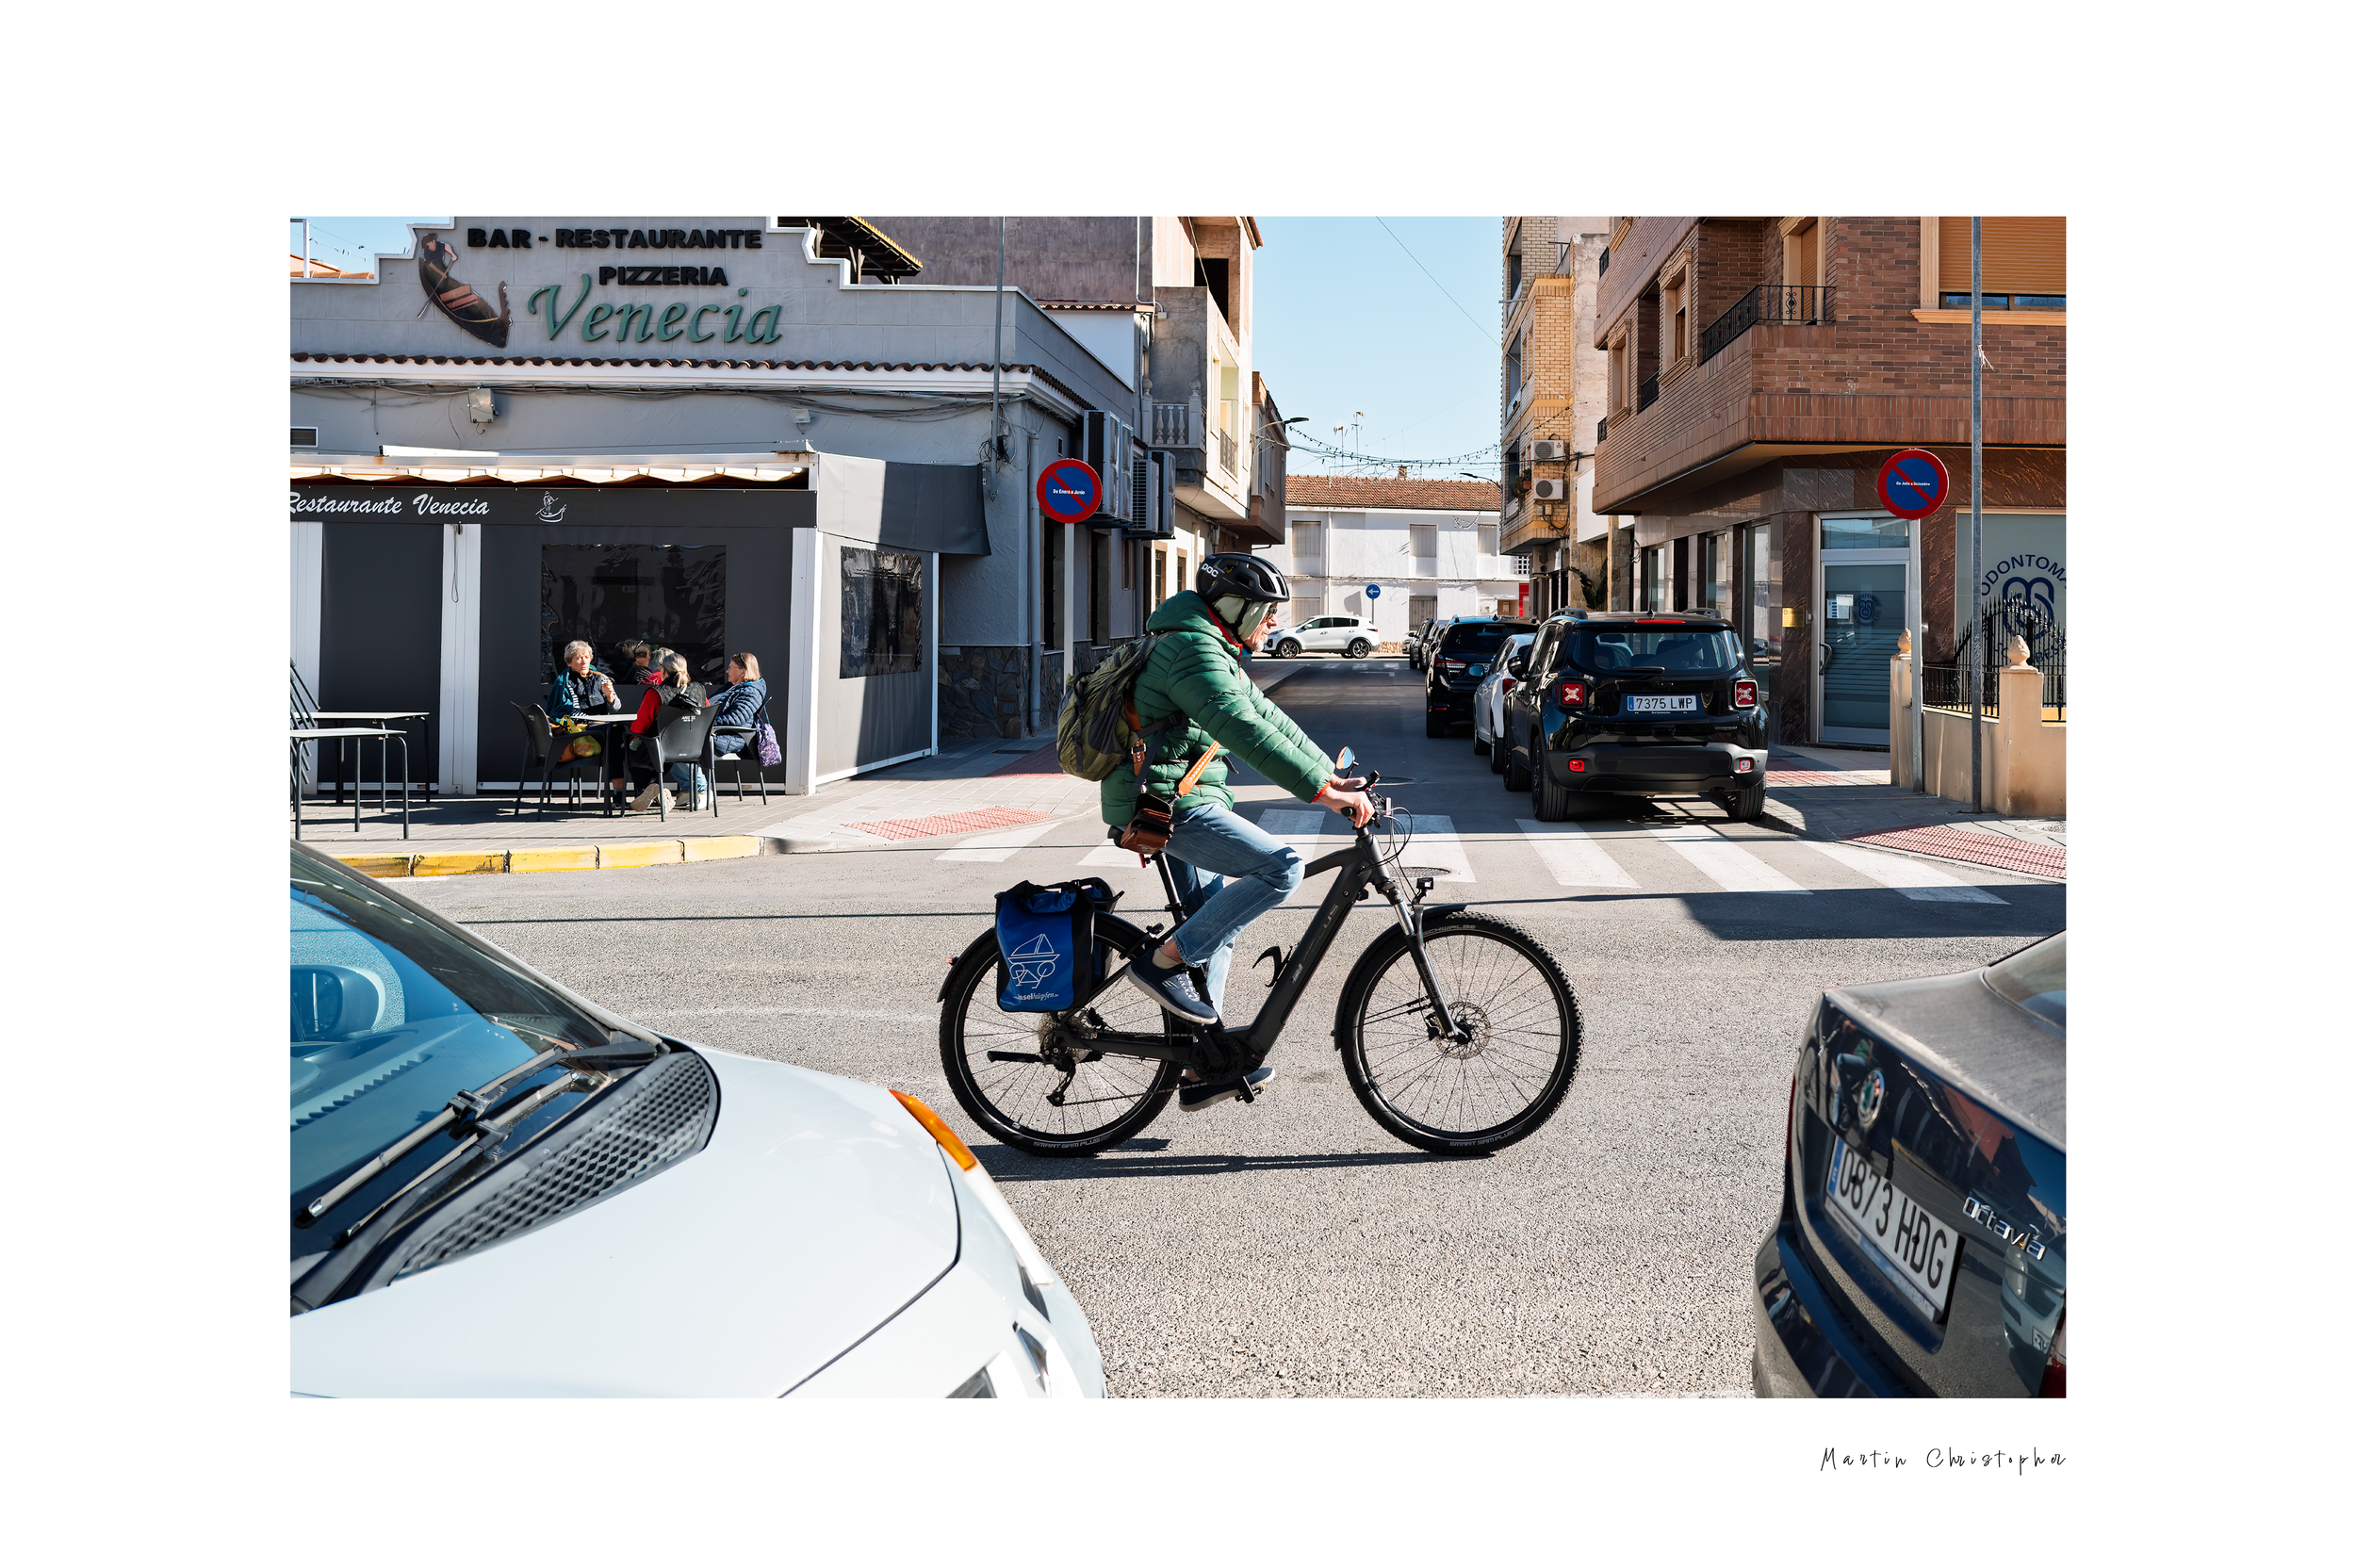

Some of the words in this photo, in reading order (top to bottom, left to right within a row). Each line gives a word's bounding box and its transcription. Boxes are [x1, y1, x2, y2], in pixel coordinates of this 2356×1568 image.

[467, 228, 532, 249] BAR
[555, 228, 762, 250] RESTAURANTE
[599, 266, 728, 286] PIZZERIA
[527, 273, 783, 344] Venecia
[290, 491, 402, 514] Restaurante
[412, 493, 490, 516] Venecia
[1636, 697, 1667, 710] 7375
[1670, 697, 1693, 710] LWP
[1423, 924, 1477, 936] SCHWALBE
[1033, 1140, 1061, 1149] SMART
[1080, 1137, 1101, 1147] PLUS
[1495, 1129, 1514, 1141] PLUS
[1840, 1149, 1893, 1237] 0873
[1894, 1197, 1947, 1289] HDG
